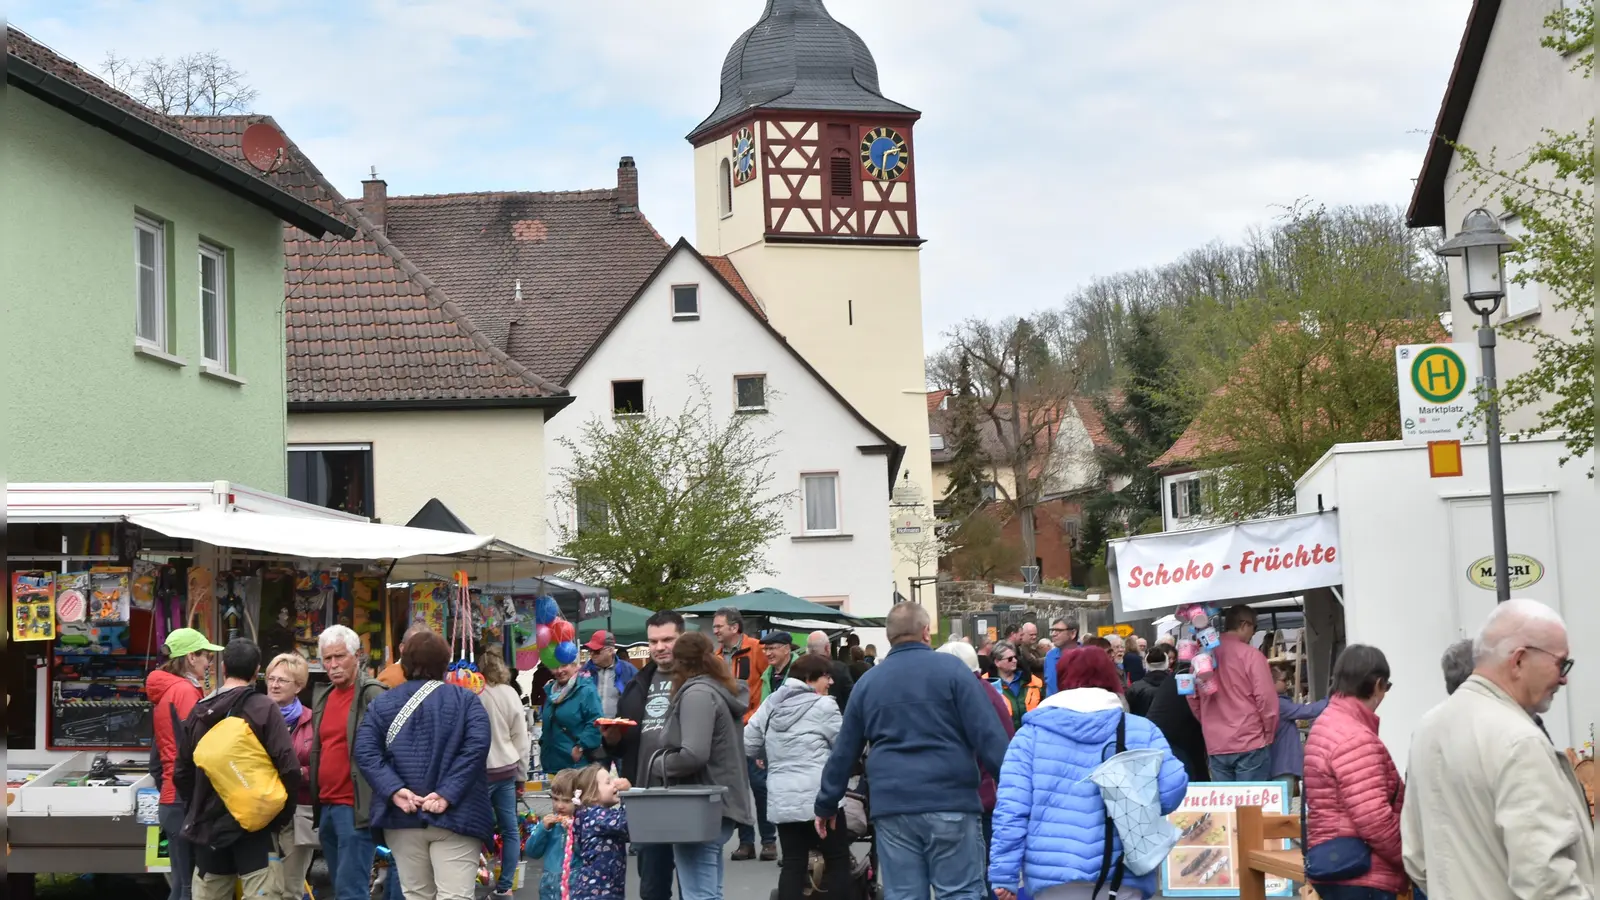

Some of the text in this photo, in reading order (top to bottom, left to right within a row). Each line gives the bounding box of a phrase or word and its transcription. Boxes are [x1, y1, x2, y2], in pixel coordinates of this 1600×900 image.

[1426, 359, 1451, 391] H
[1419, 405, 1463, 415] Marktplatz
[1127, 558, 1215, 589] Schoko
[1239, 543, 1337, 574] Früchte
[1183, 788, 1279, 808] ruchtspieße
